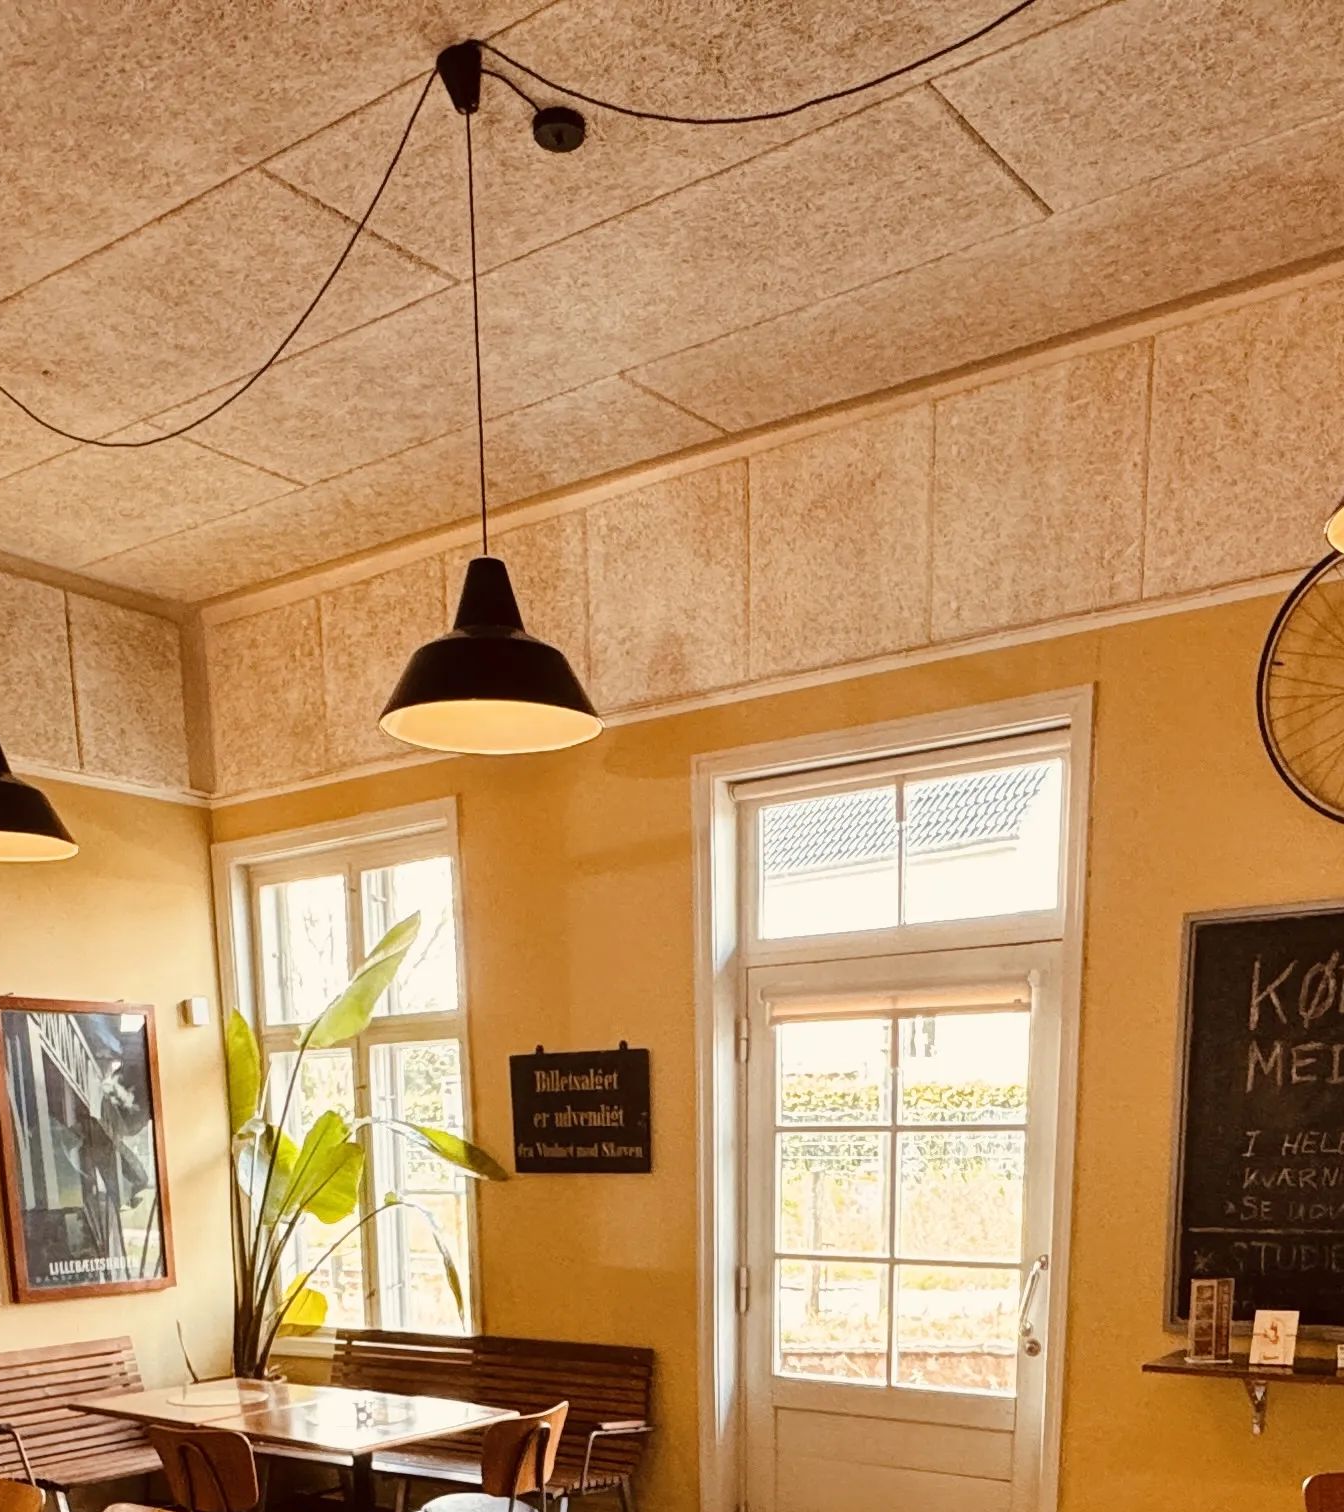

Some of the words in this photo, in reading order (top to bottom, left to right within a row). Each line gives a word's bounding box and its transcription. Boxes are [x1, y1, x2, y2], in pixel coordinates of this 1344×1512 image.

[534, 1068, 618, 1092] Billetsalget
[533, 1112, 550, 1128] er
[554, 1104, 624, 1128] udvendigt
[1242, 1130, 1260, 1158] I
[1239, 1196, 1272, 1222] SE
